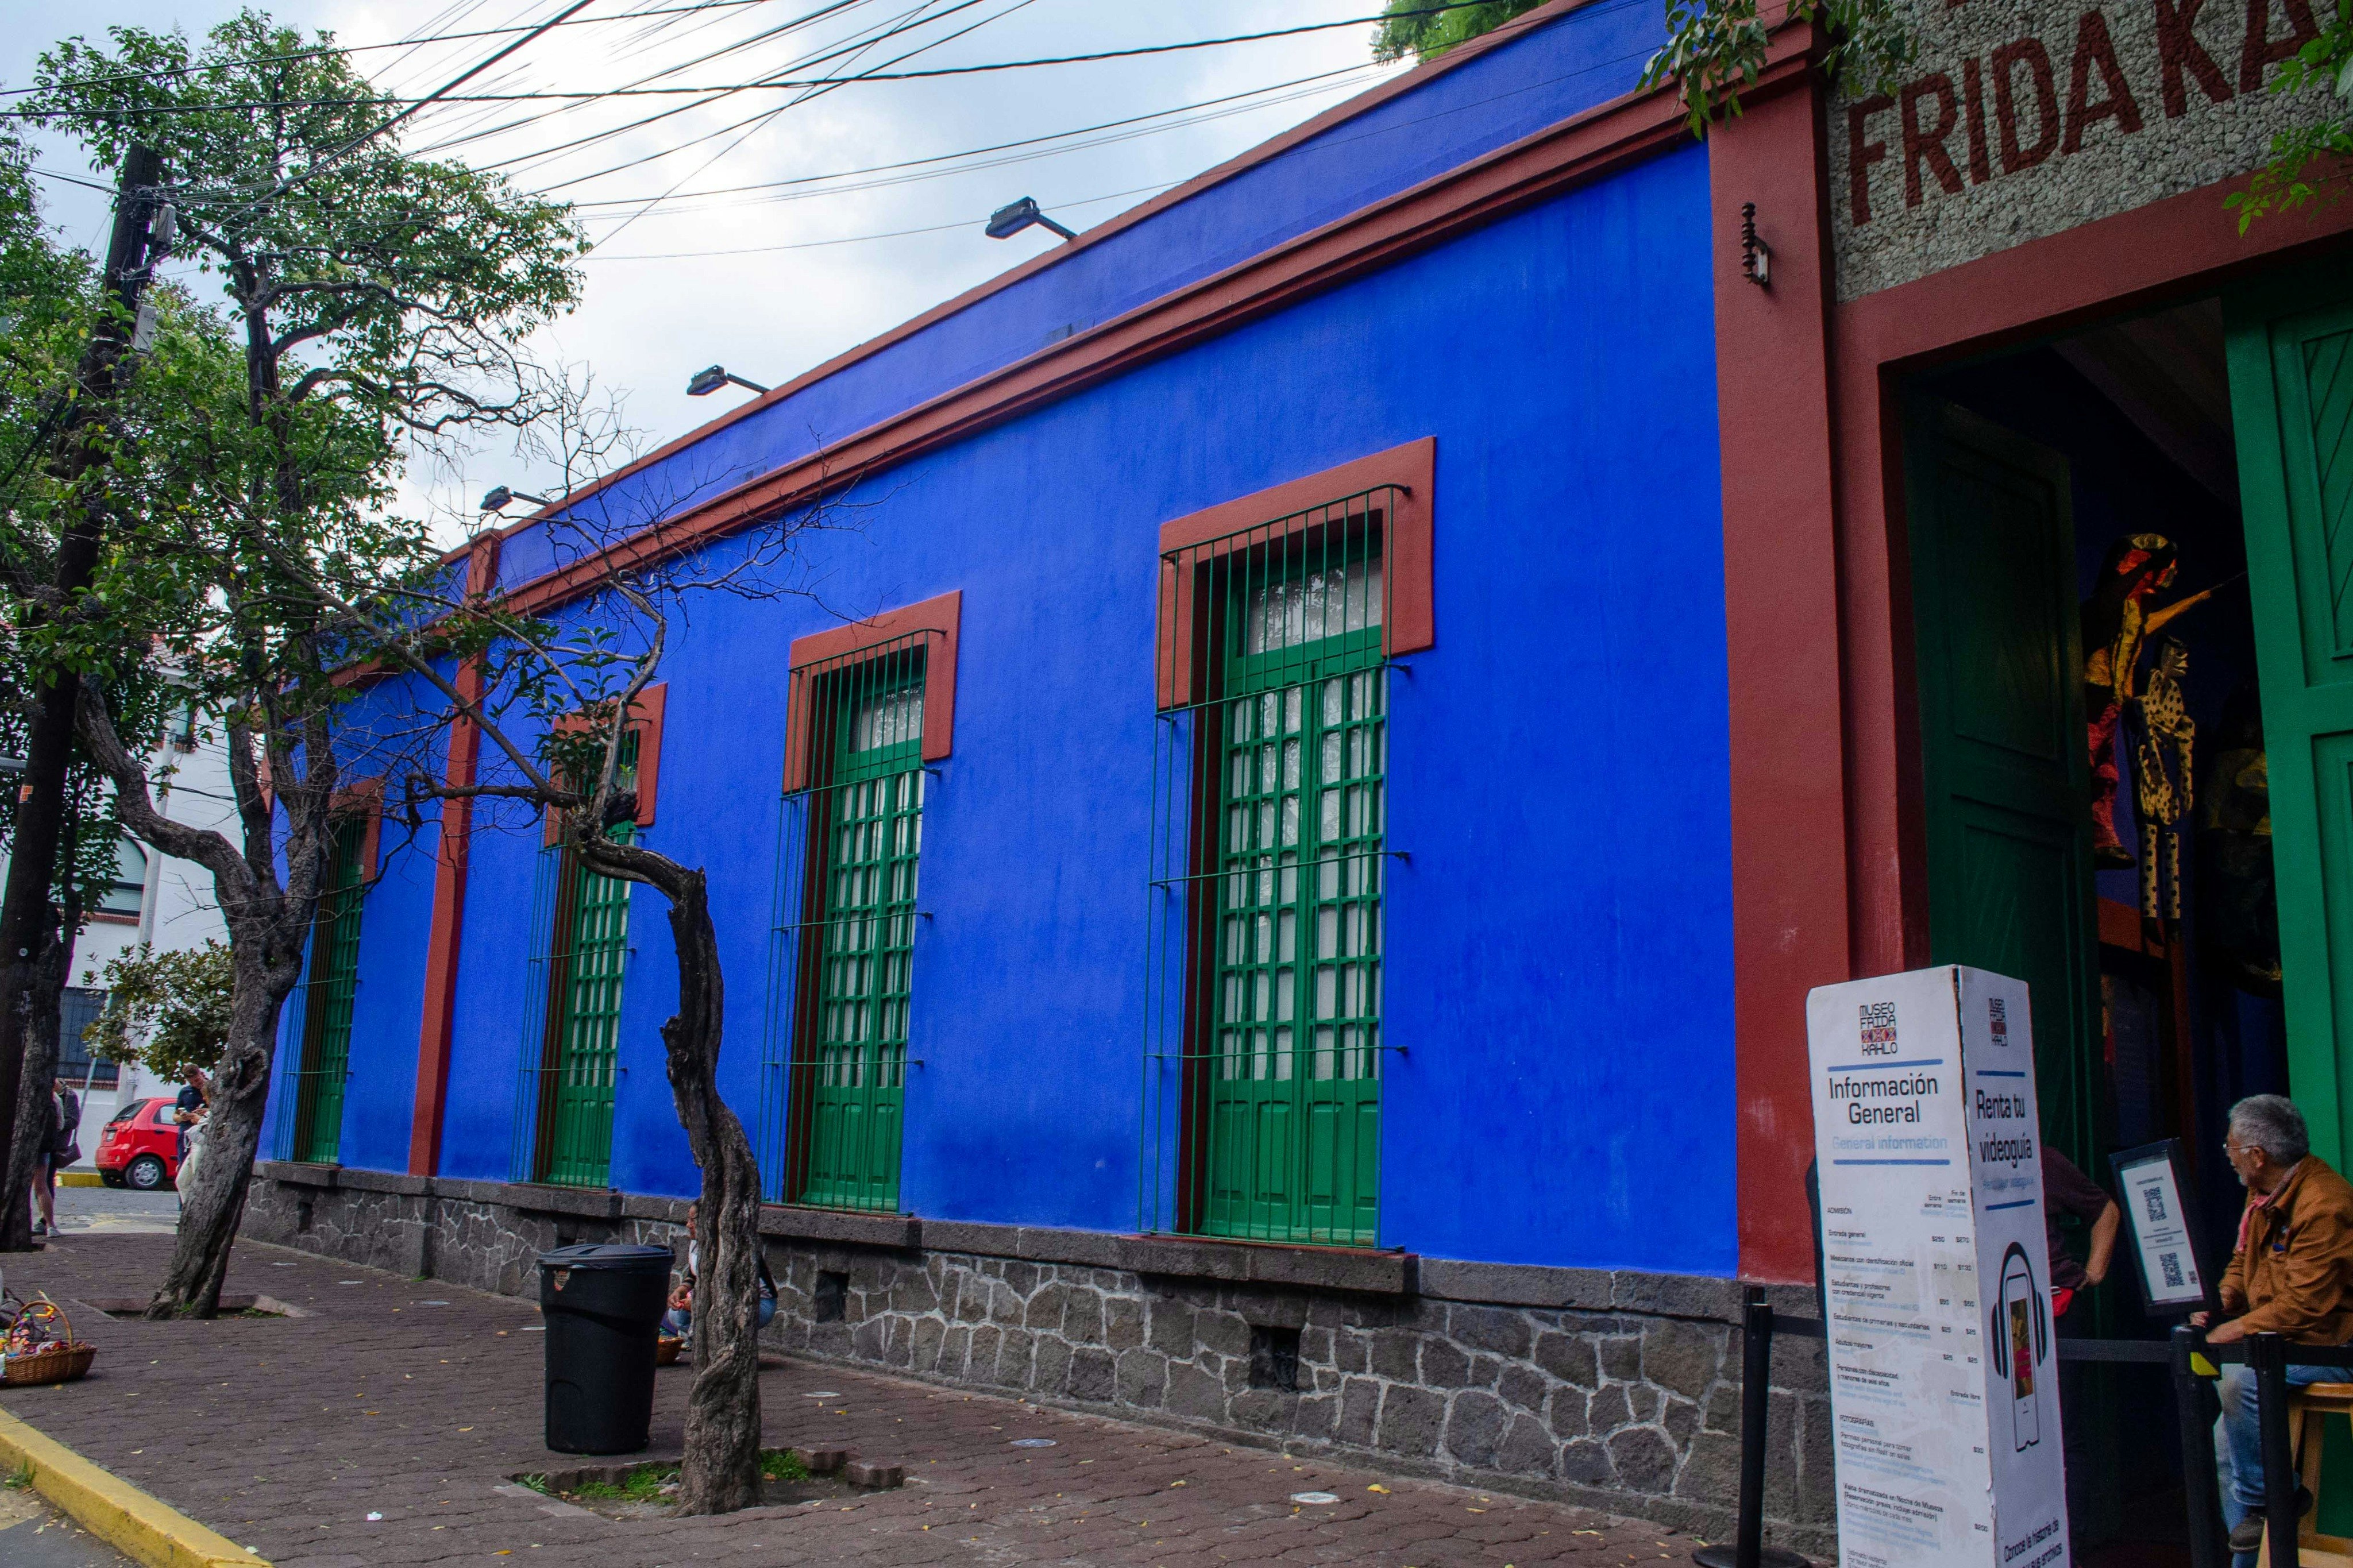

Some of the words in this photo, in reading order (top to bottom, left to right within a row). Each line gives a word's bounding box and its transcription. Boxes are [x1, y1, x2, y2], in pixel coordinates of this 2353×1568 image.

[1848, 10, 2144, 227] FRIDA
[2155, 0, 2353, 118] KA
[1860, 1002, 1895, 1017] MUSEO
[1860, 1015, 1896, 1029] FRIDA
[1862, 1042, 1897, 1057] KAHLO
[1992, 1036, 2008, 1046] KAHLO
[1829, 1072, 1938, 1099] Información
[1849, 1099, 1920, 1124] General
[1976, 1090, 2011, 1119] Renta
[2013, 1094, 2025, 1118] tu
[1833, 1136, 1874, 1149] General
[1878, 1134, 1948, 1149] information
[1980, 1132, 2032, 1168] videoguía
